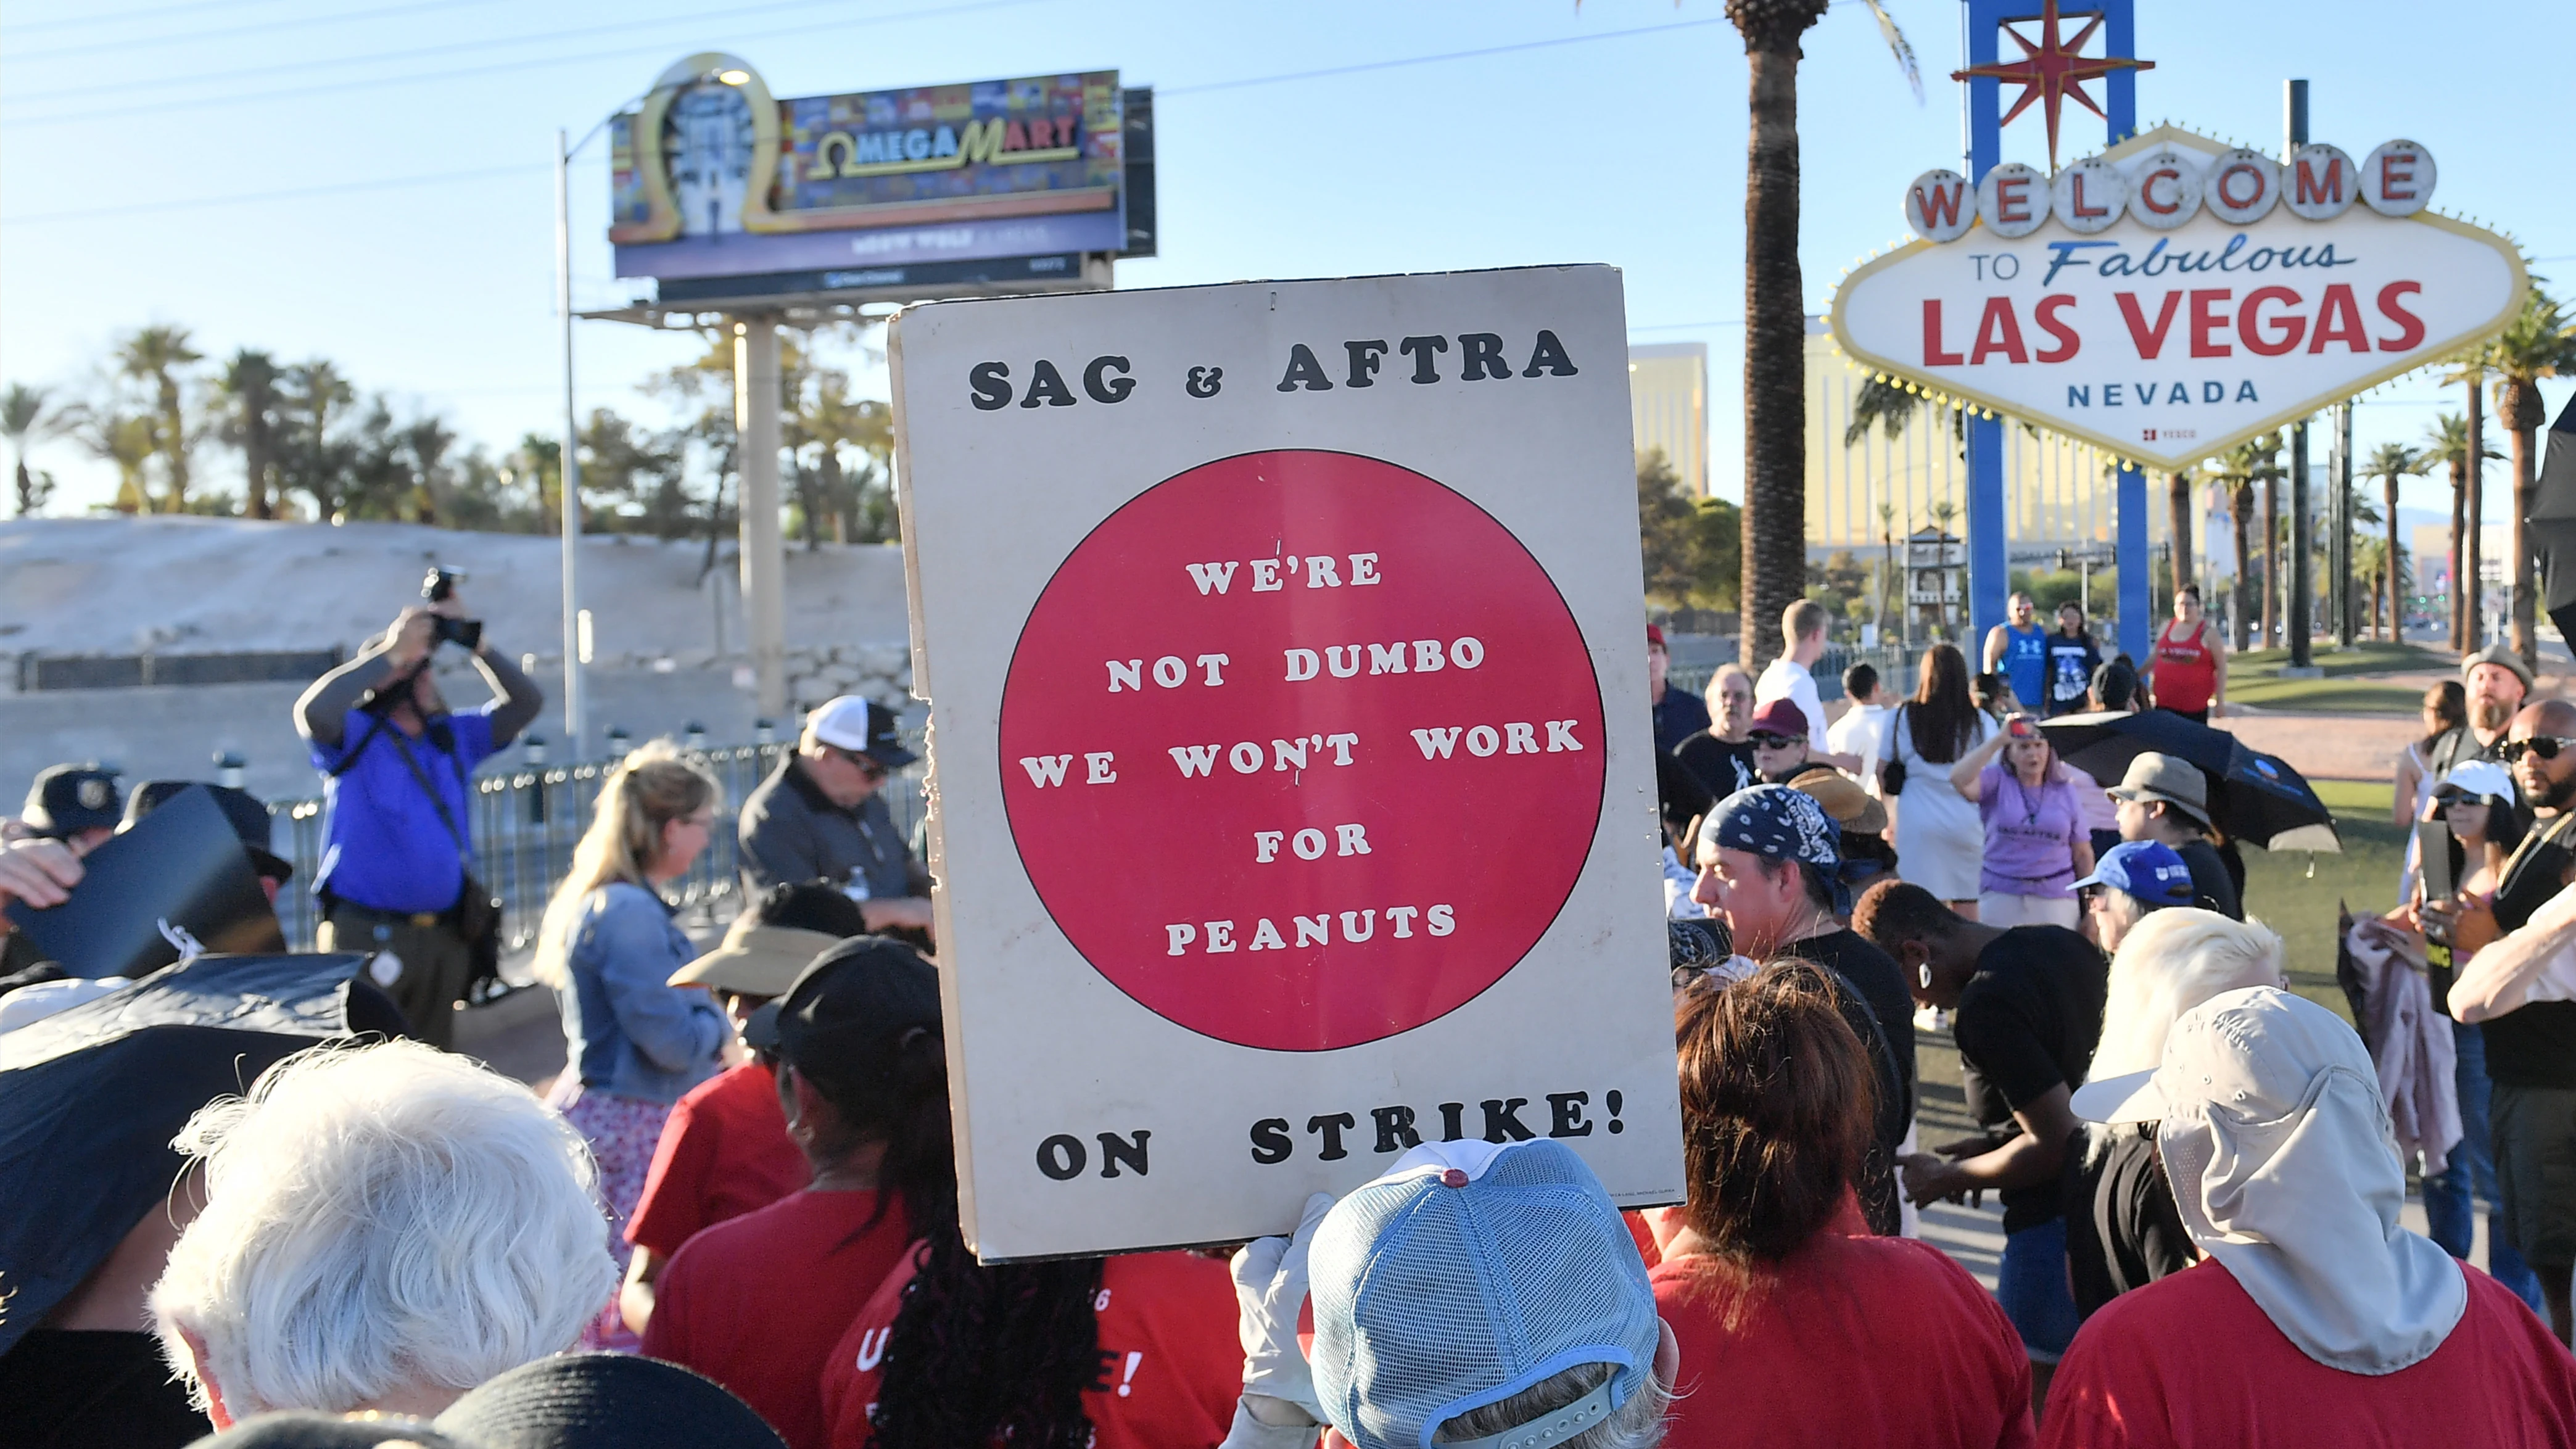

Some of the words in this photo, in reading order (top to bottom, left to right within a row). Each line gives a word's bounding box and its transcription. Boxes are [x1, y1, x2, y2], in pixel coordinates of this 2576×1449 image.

[1914, 154, 2417, 229] WELCOME
[1968, 253, 2020, 281] TO
[2042, 233, 2357, 287] Fabulous
[1923, 294, 2081, 366] LAS
[2114, 281, 2426, 360] VEGAS
[968, 355, 1137, 411] SAG
[1185, 365, 1224, 399] &
[1276, 329, 1579, 393] AFTRA
[2067, 379, 2259, 408] NEVADA
[1184, 551, 1382, 596] WE'RE
[1105, 653, 1230, 693] NOT
[1283, 636, 1485, 682] DUMBO
[1018, 751, 1118, 789] WE
[1167, 732, 1360, 779] WON'T
[1410, 719, 1584, 761] WORK
[1253, 822, 1373, 864] FOR
[1165, 903, 1456, 957] PEANUTS
[1036, 1129, 1152, 1181] ON
[1249, 1089, 1624, 1165] STRIKE!
